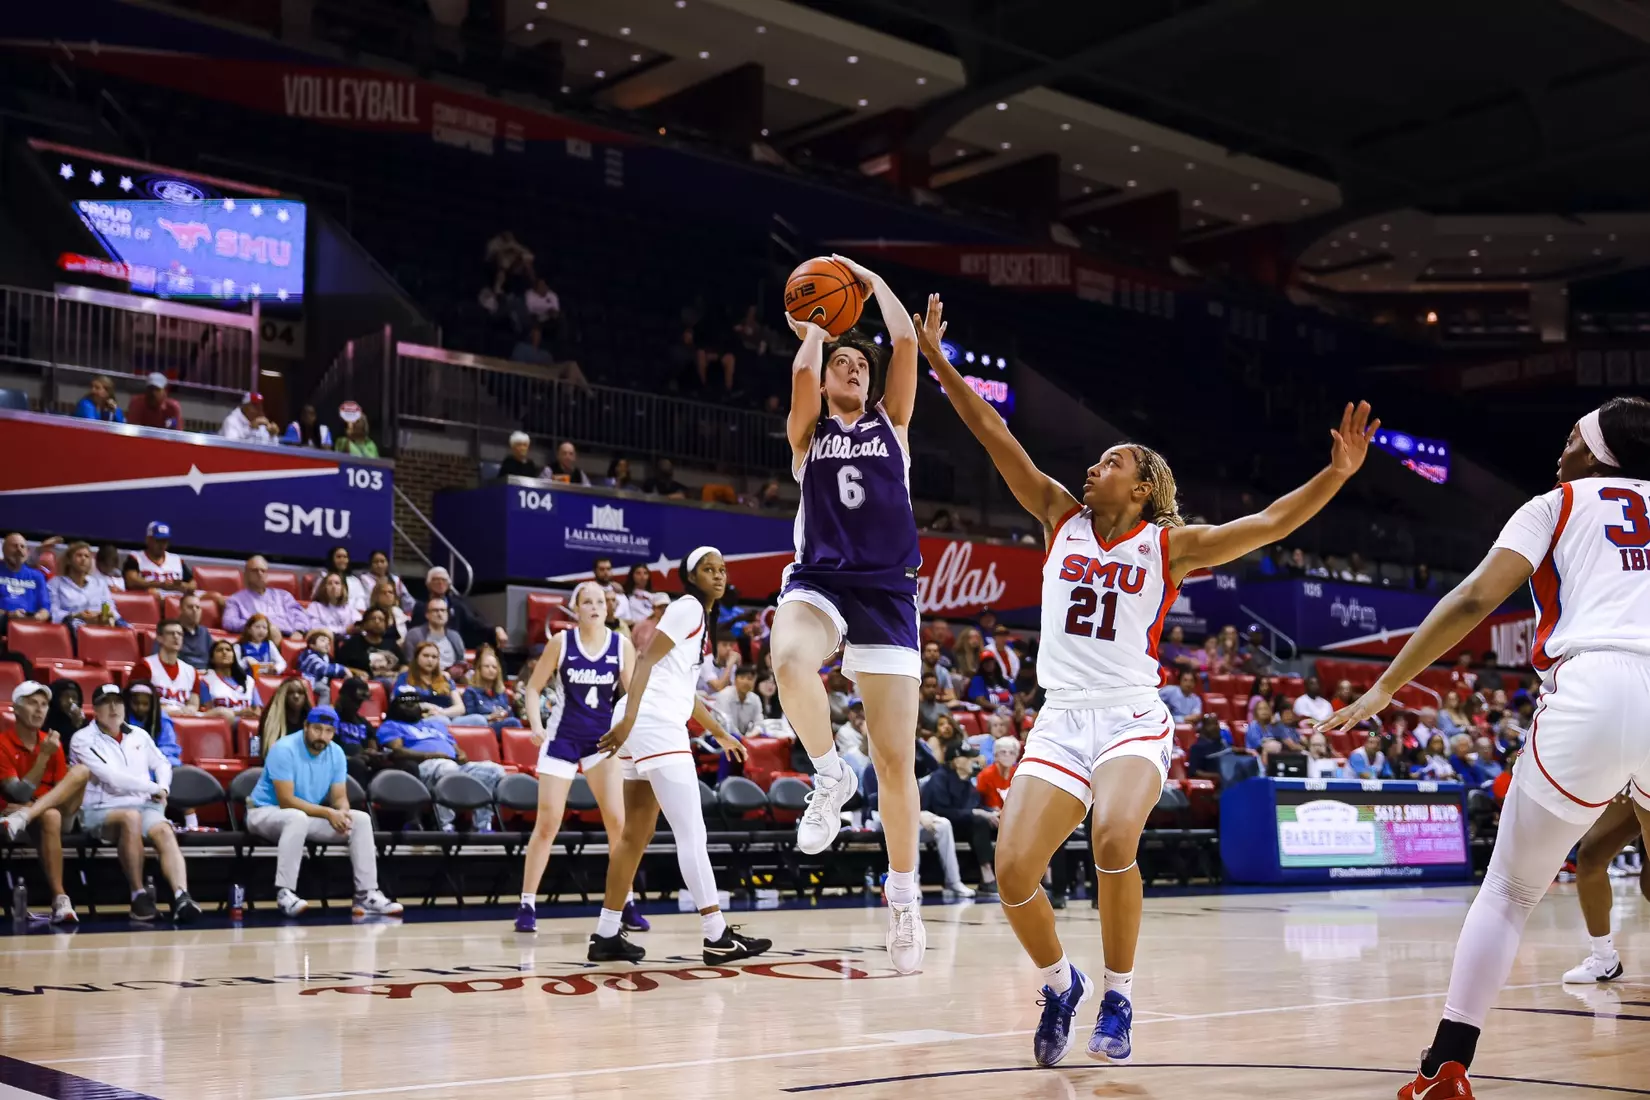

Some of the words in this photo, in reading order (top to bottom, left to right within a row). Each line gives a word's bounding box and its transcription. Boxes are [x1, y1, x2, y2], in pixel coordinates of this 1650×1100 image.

[284, 74, 420, 124] VOLLEYBALL
[214, 227, 292, 267] SMU
[988, 251, 1072, 286] BASKETBALL
[810, 432, 890, 463] Wildcats
[345, 467, 384, 491] 103
[836, 464, 867, 510] 6
[518, 489, 553, 512] 104
[1597, 486, 1650, 549] 3
[264, 502, 352, 539] SMU
[917, 540, 1007, 614] allas
[1058, 553, 1147, 595] SMU
[1619, 548, 1650, 572] IB
[1064, 585, 1119, 642] 21
[566, 667, 615, 685] Wildcats
[584, 685, 600, 710] 4
[298, 959, 924, 999] Dallas
